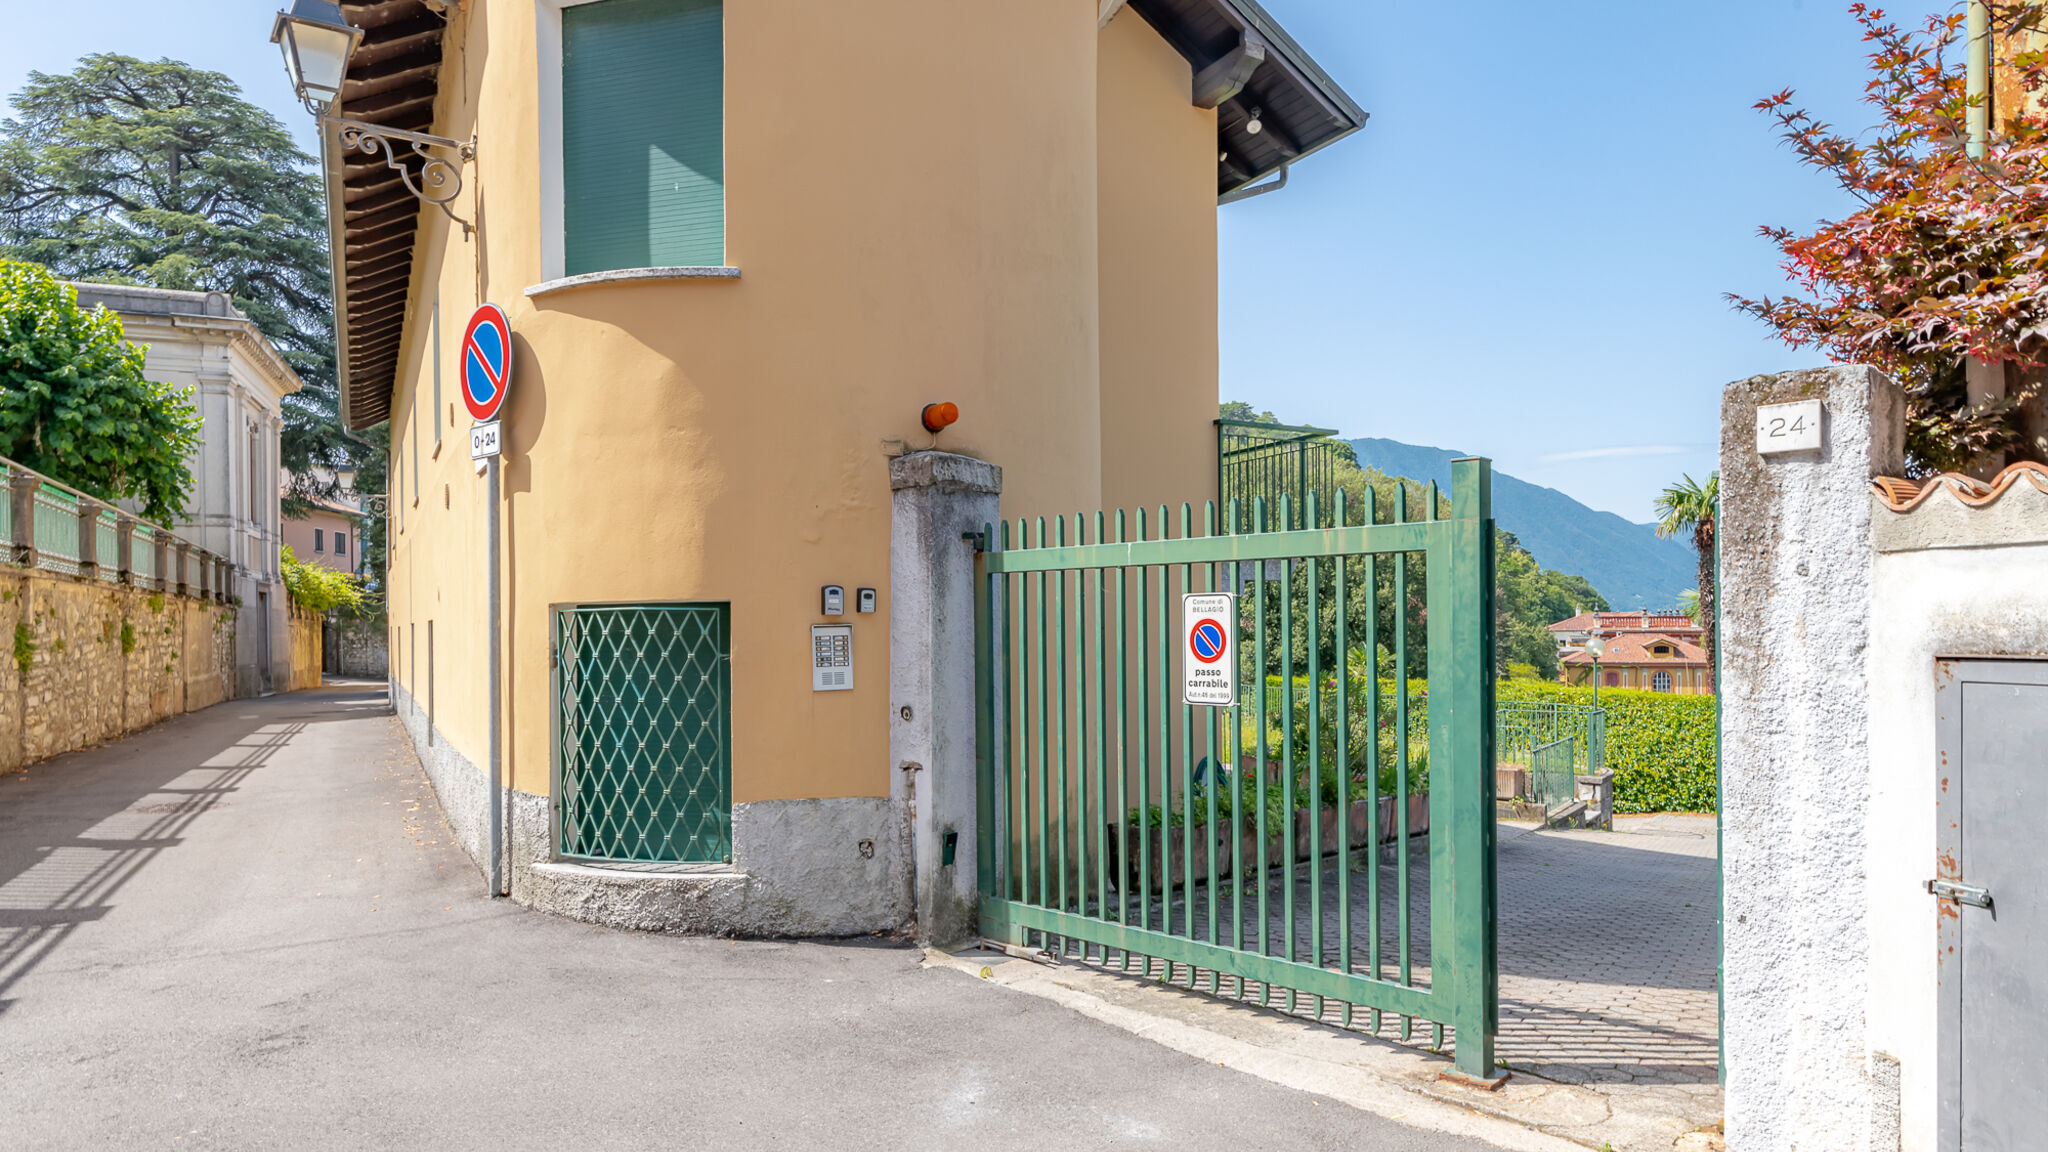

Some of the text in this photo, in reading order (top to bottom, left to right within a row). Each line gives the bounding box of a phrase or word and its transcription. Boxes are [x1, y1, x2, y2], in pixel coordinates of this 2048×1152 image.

[1770, 415, 1806, 437] 24
[1195, 669, 1222, 677] passo
[1188, 679, 1229, 688] carrabile
